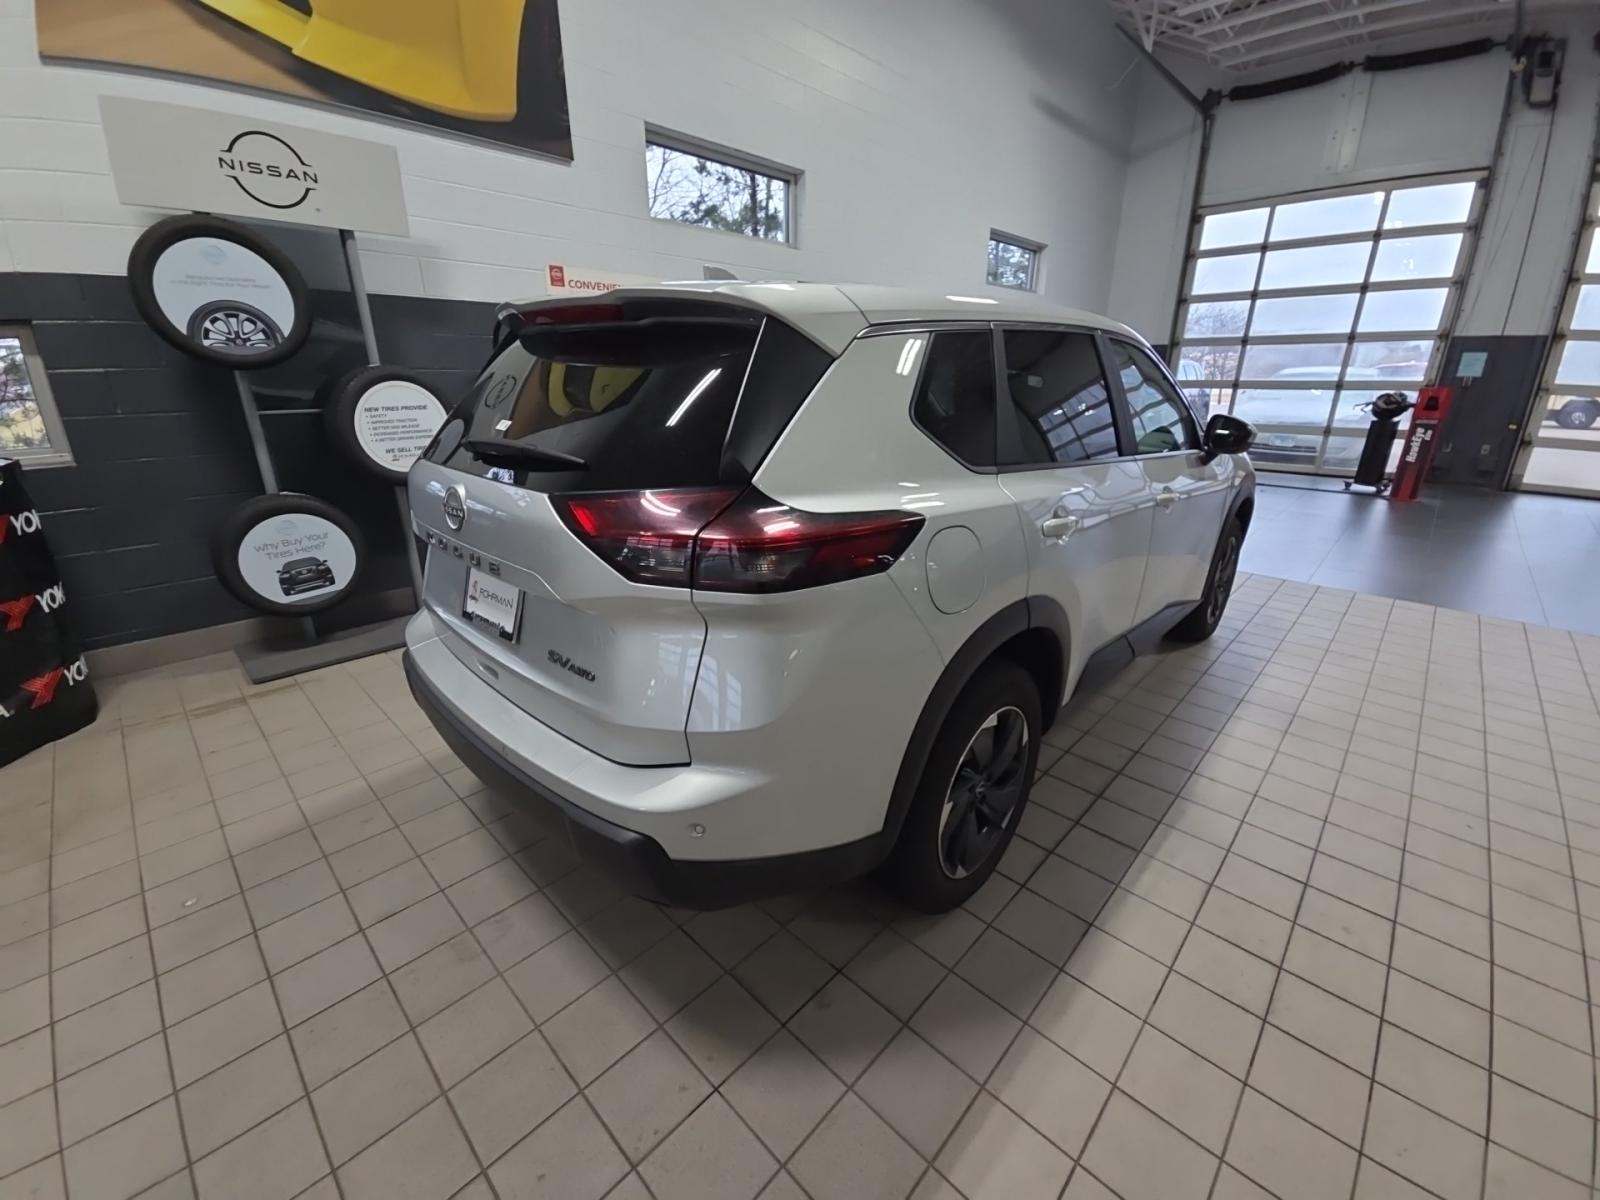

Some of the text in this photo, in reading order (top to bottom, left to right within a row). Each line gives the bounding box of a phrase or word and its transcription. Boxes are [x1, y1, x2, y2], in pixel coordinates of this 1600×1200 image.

[218, 156, 319, 184] NISSAN
[568, 279, 622, 292] CONVENIE
[254, 532, 328, 553] Why Buy Your
[265, 542, 326, 560] Tires Here?
[547, 649, 571, 669] SV
